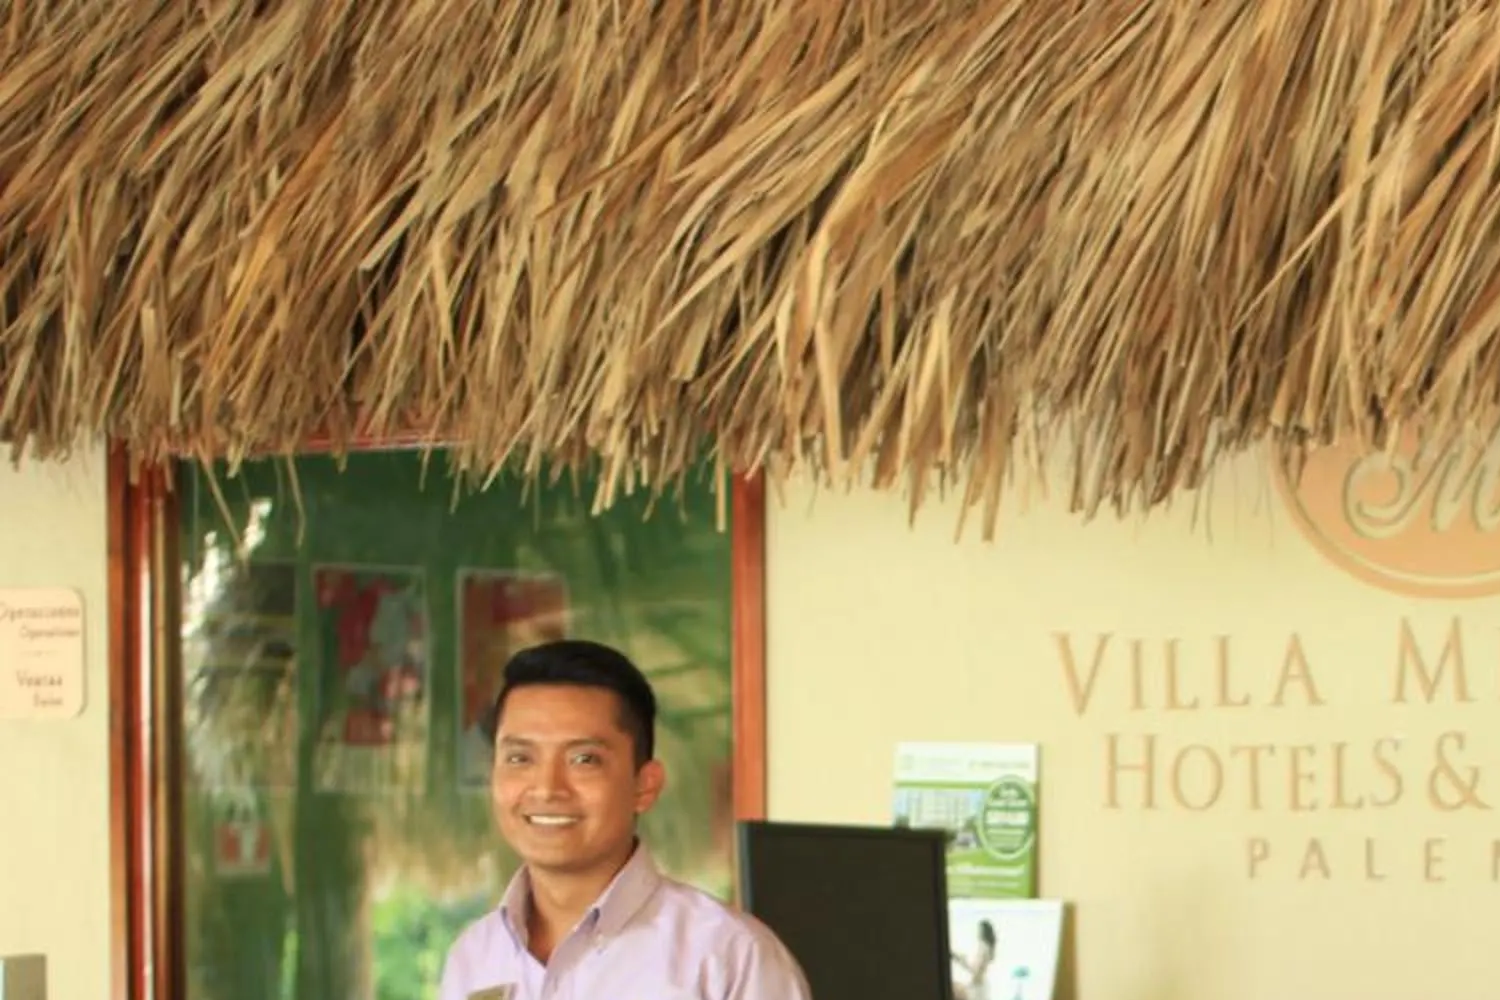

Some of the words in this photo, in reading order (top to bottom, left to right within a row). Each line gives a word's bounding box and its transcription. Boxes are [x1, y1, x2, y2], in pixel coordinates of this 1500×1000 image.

[1049, 630, 1326, 719] VILLA
[1102, 733, 1404, 813] HOTELS
[1427, 729, 1494, 813] &
